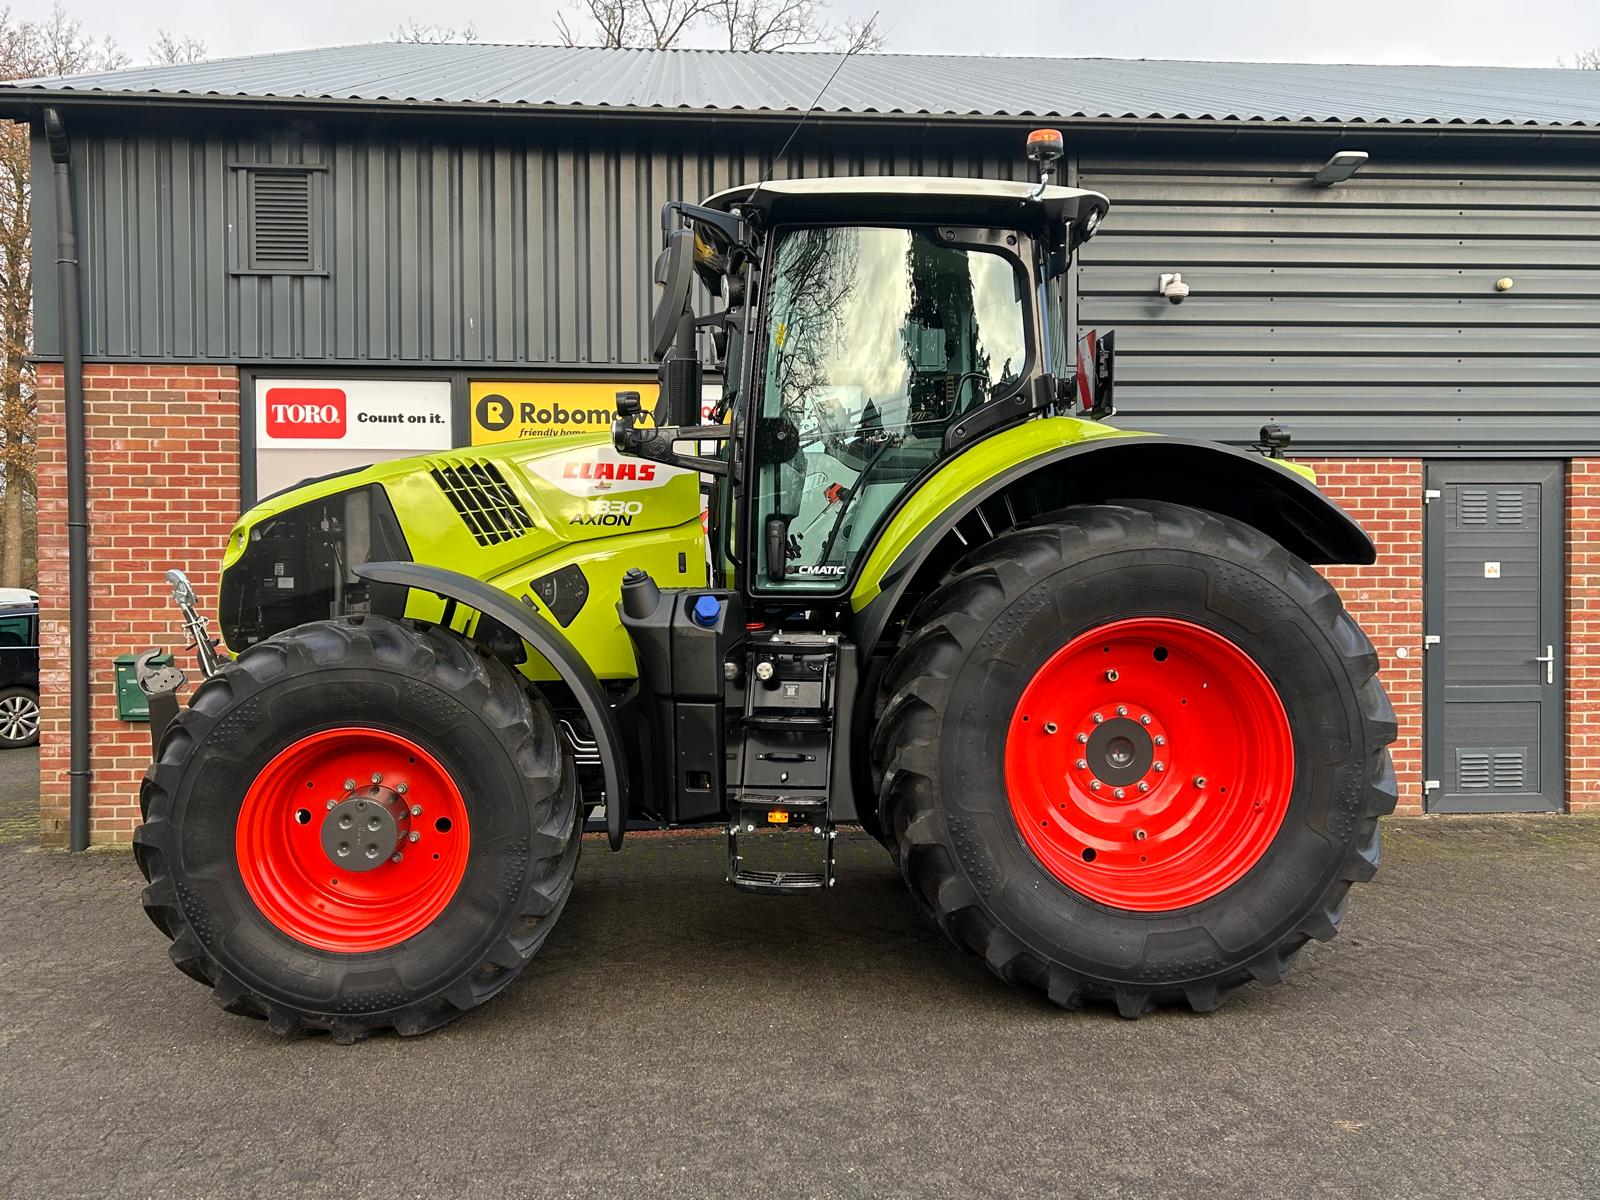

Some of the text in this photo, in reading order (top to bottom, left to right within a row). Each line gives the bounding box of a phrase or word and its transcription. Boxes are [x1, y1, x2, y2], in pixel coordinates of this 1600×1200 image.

[272, 404, 338, 424] TORO
[357, 413, 446, 424] Count on it.
[518, 427, 559, 438] friendly
[564, 463, 656, 481] CLAAS
[595, 500, 643, 515] 830
[569, 513, 631, 526] AXION
[798, 565, 846, 575] CMATIC
